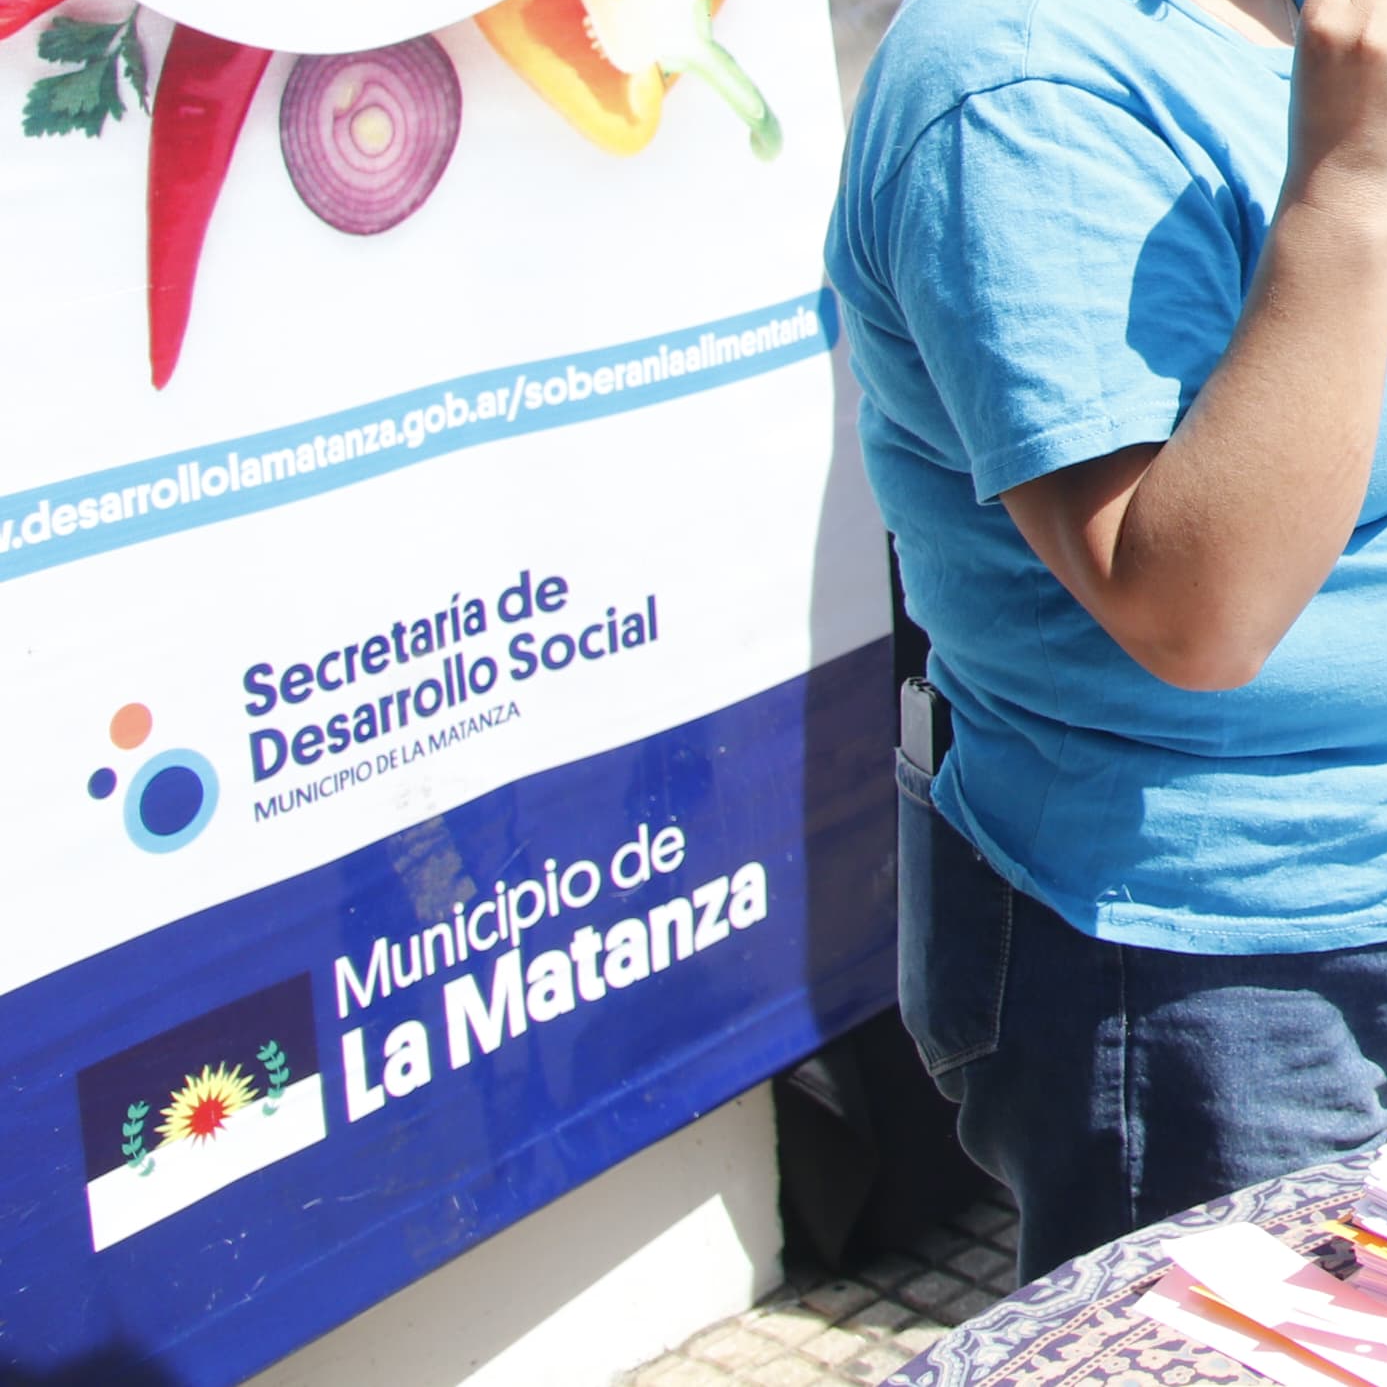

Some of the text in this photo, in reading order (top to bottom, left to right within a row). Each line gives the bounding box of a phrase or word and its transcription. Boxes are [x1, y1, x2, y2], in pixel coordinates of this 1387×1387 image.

[243, 569, 569, 717] Secretaría de
[248, 594, 658, 782] Desarrollo Social
[253, 700, 521, 822] MUNICIPIO DE LA MATANZA
[334, 822, 686, 1019] Municipio de
[341, 861, 768, 1123] La Matanza
